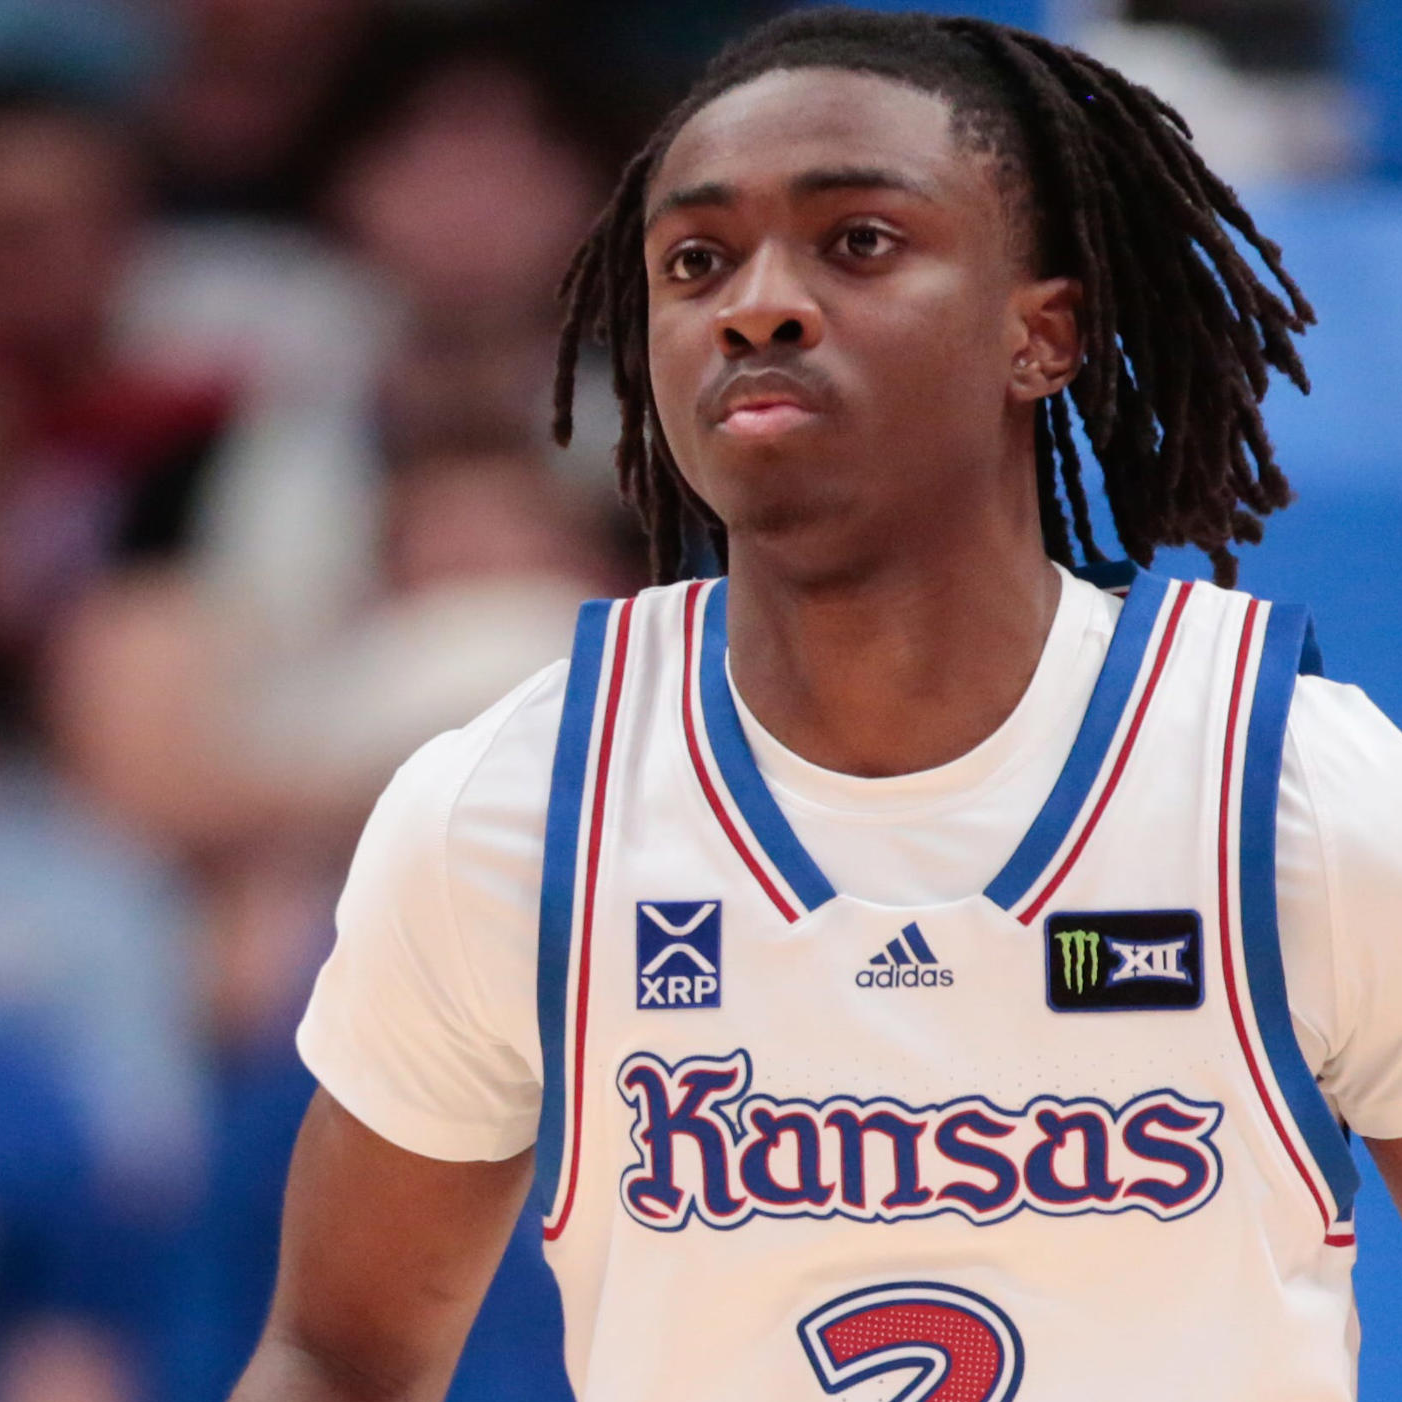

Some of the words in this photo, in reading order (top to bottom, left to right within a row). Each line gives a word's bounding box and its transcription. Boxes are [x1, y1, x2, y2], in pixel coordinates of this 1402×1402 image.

[855, 964, 954, 989] adidas
[1108, 938, 1189, 984] XII
[641, 976, 717, 1004] XRP
[617, 1049, 1223, 1231] Kansas
